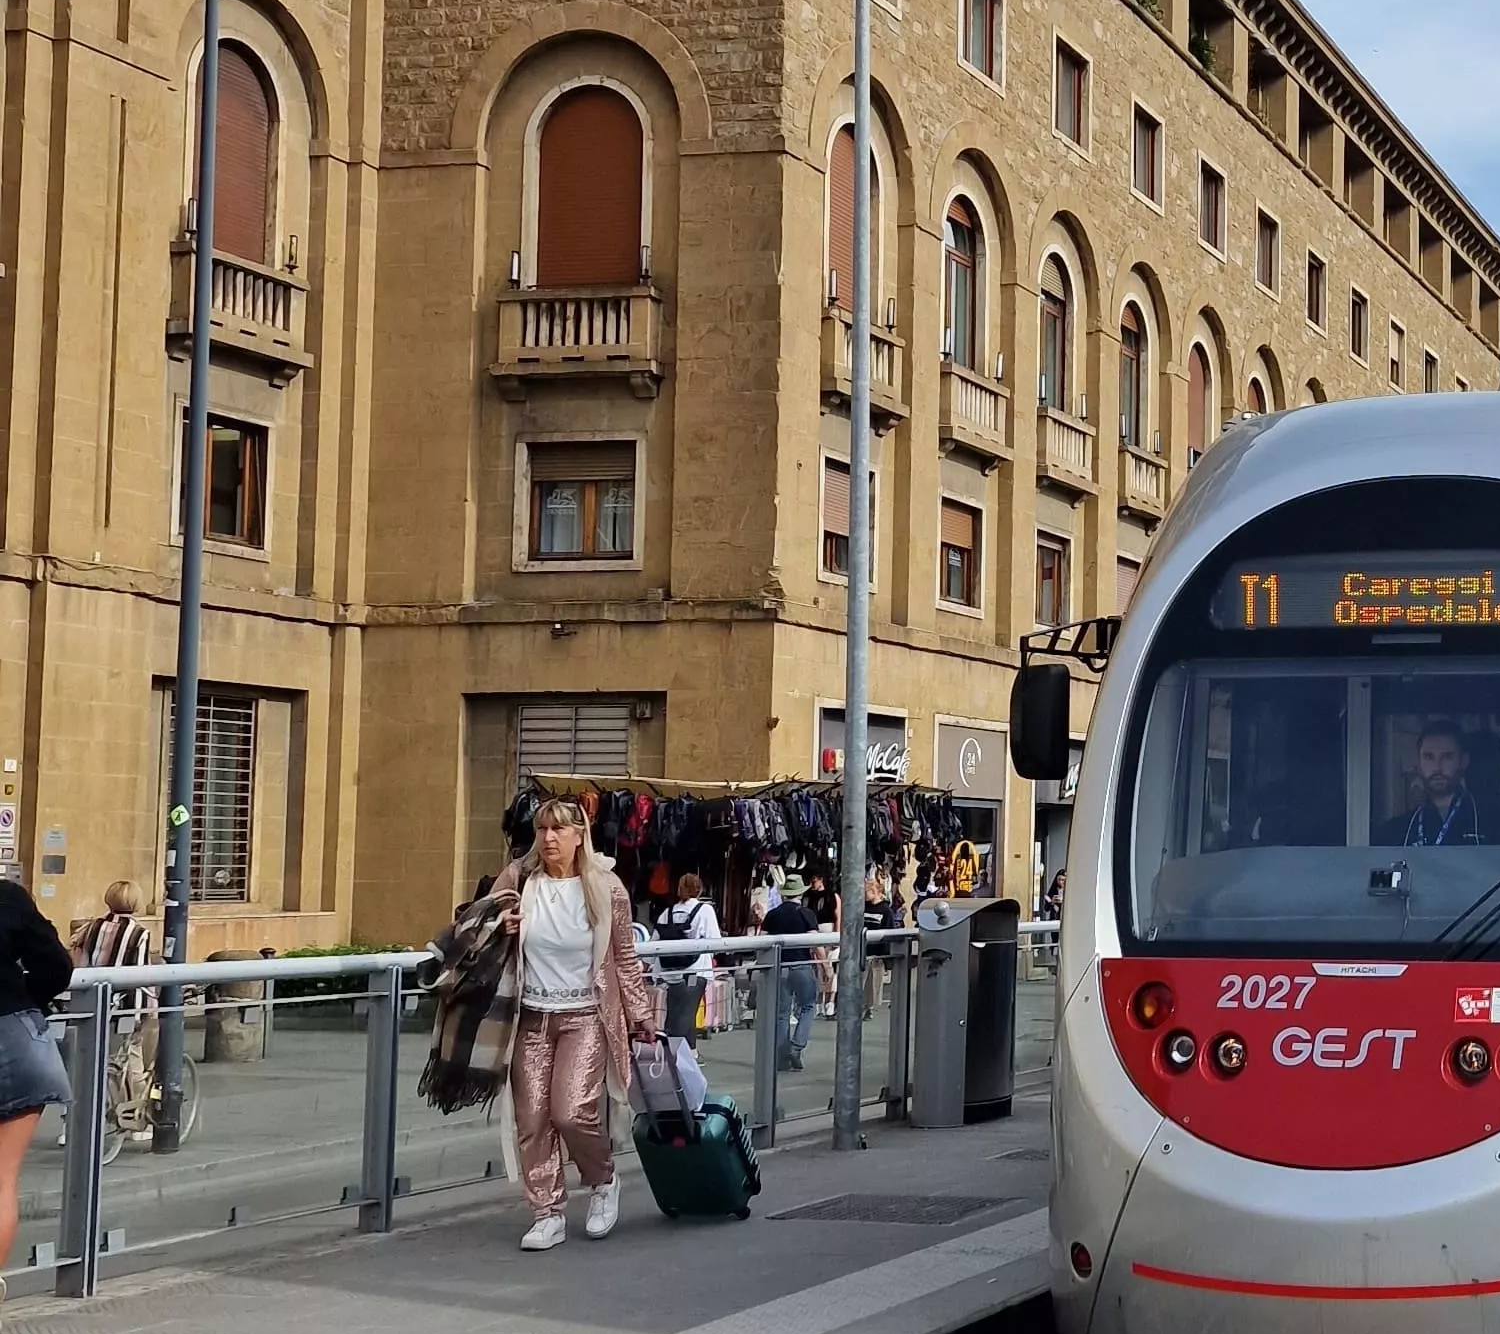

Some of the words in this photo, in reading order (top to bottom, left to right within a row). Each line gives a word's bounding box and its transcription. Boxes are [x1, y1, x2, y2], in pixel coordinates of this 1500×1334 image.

[1343, 570, 1496, 596] Careggi
[1240, 572, 1279, 626] T1
[960, 858, 973, 880] 24
[1340, 966, 1377, 975] HITACHI
[1216, 975, 1317, 1009] 2027
[1272, 1026, 1417, 1070] GEST
